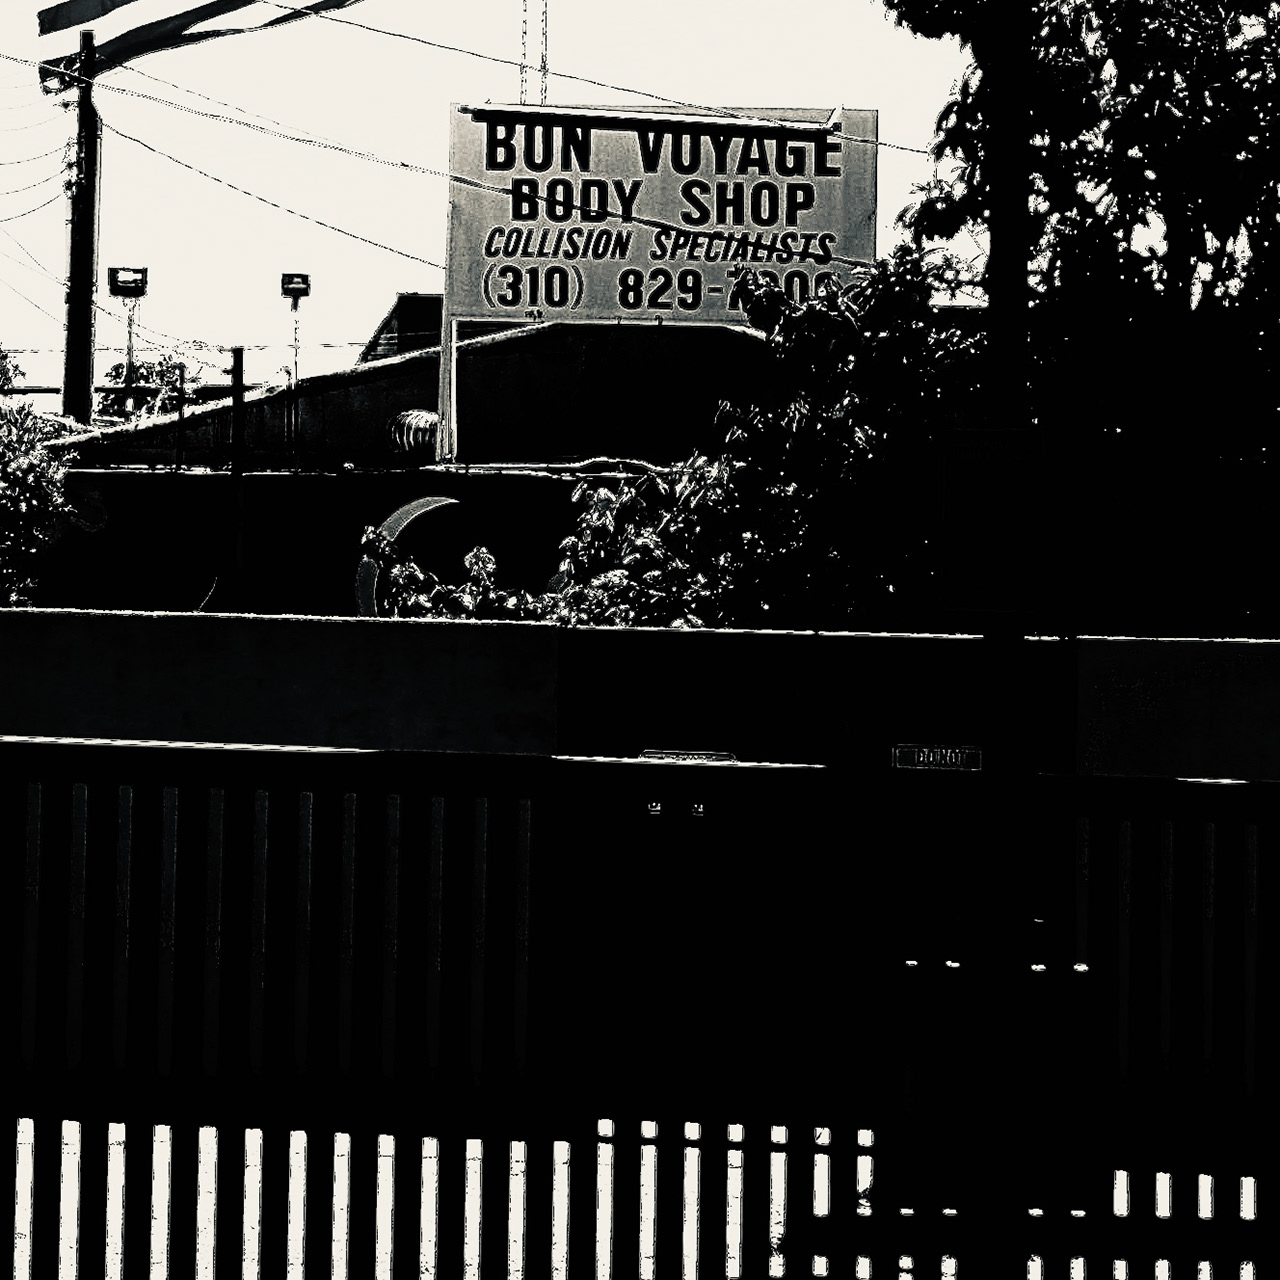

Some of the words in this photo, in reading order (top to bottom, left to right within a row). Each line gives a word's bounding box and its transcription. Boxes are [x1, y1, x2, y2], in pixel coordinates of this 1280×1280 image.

[637, 126, 841, 177] VOYAGE
[511, 177, 643, 224] BODY
[680, 179, 815, 227] SHOP
[484, 226, 633, 260] COLLISION
[649, 228, 836, 265] SPECIALISTS
[483, 263, 584, 310] (310)
